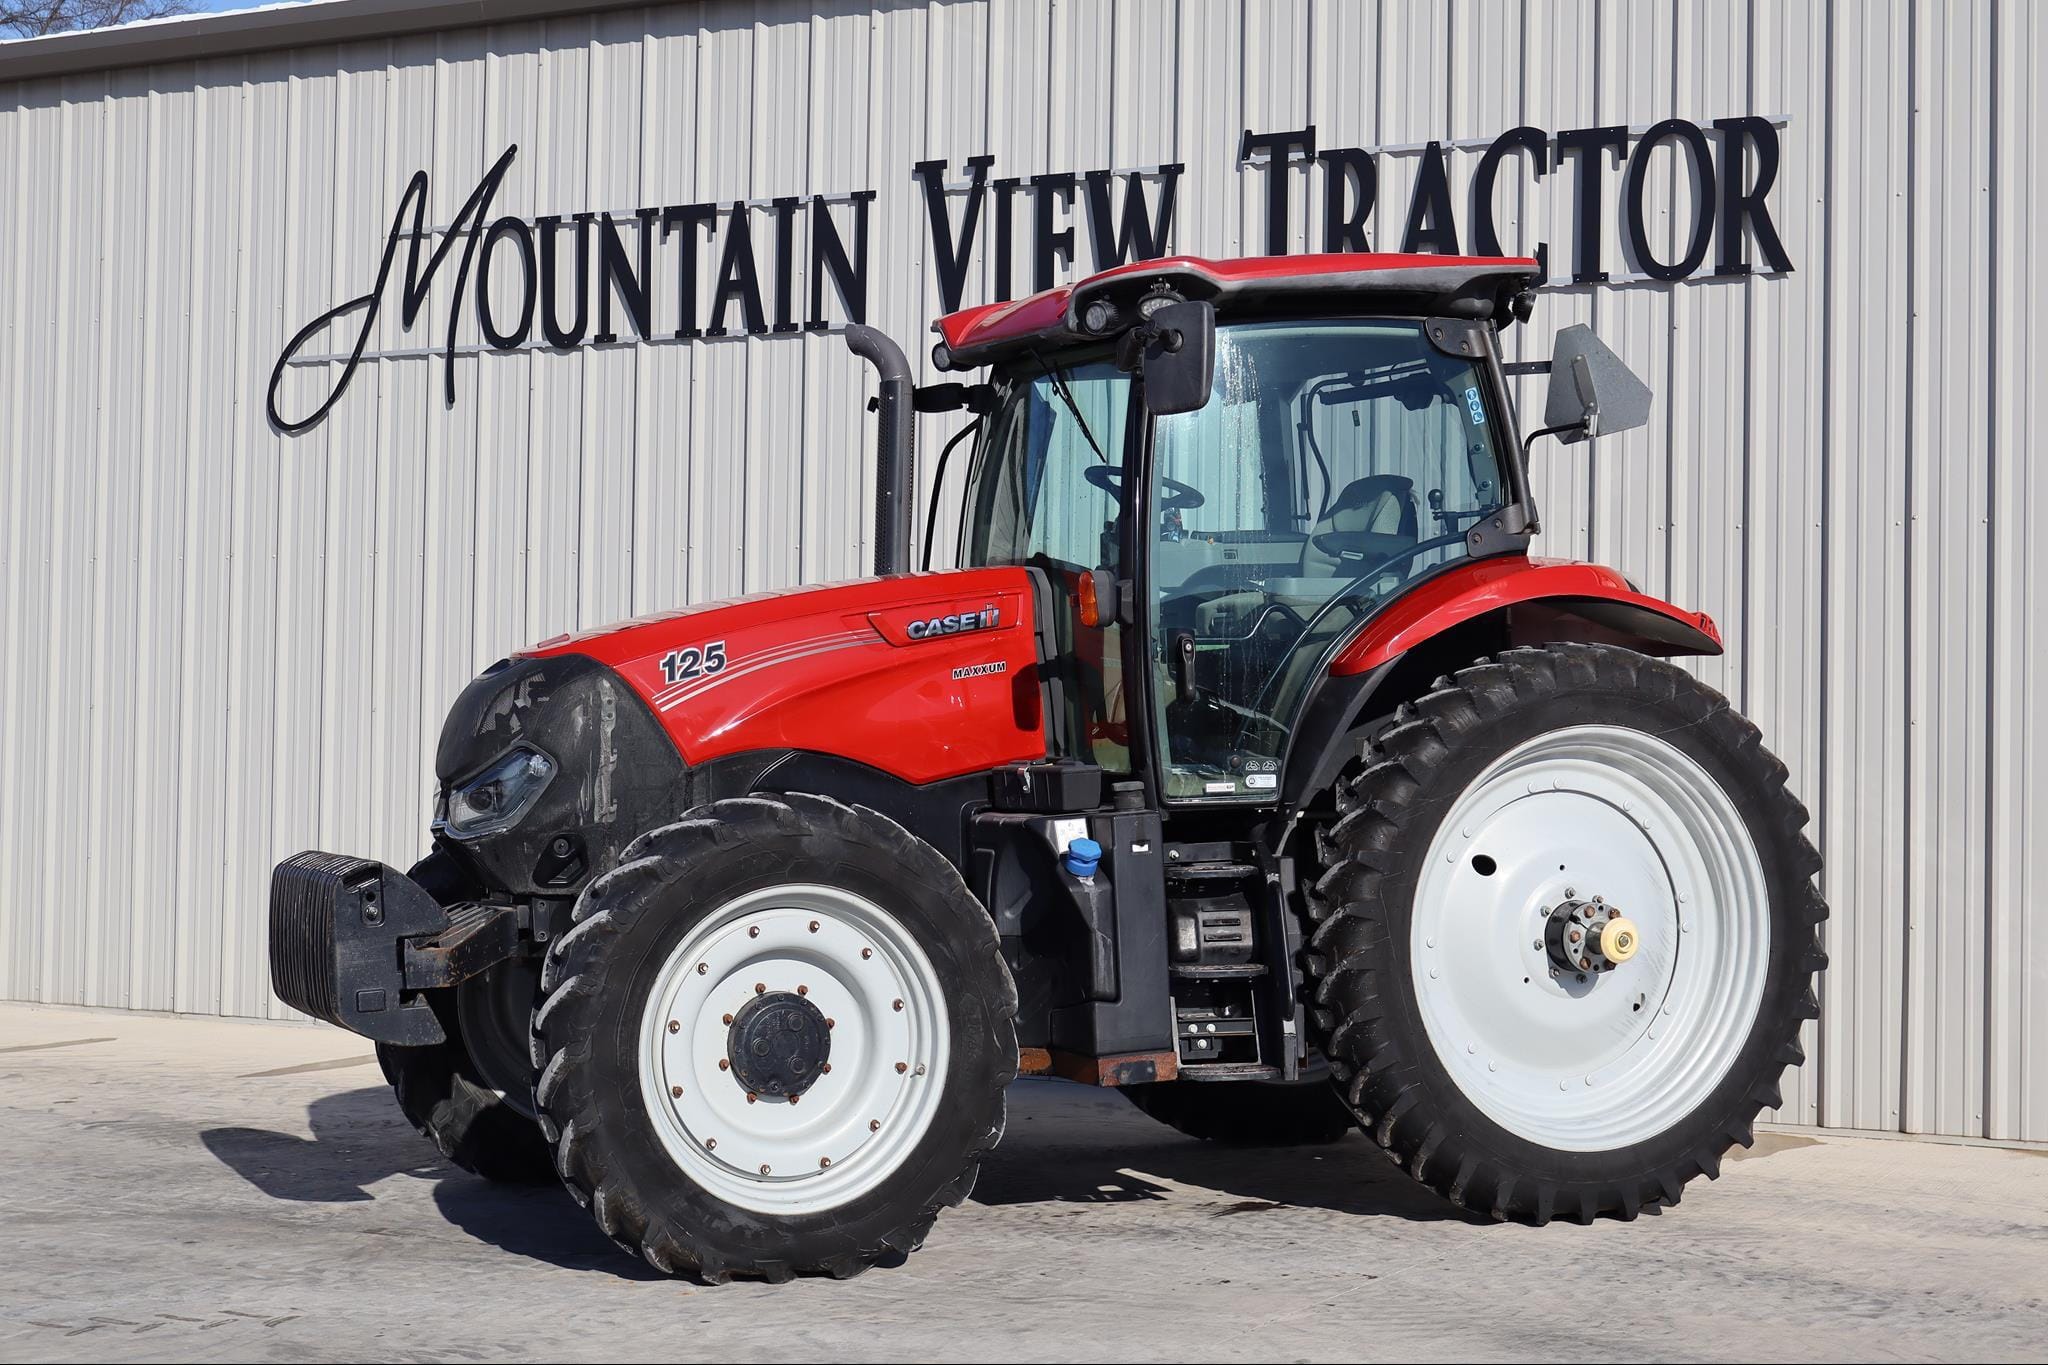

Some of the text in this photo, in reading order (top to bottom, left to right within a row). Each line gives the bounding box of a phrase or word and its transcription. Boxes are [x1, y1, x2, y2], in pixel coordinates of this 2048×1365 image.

[267, 116, 1796, 432] MOUNTAIN VIEW TRACTOR
[906, 611, 977, 640] CASE
[659, 640, 728, 685] 125
[952, 661, 1007, 680] MAXXUM
